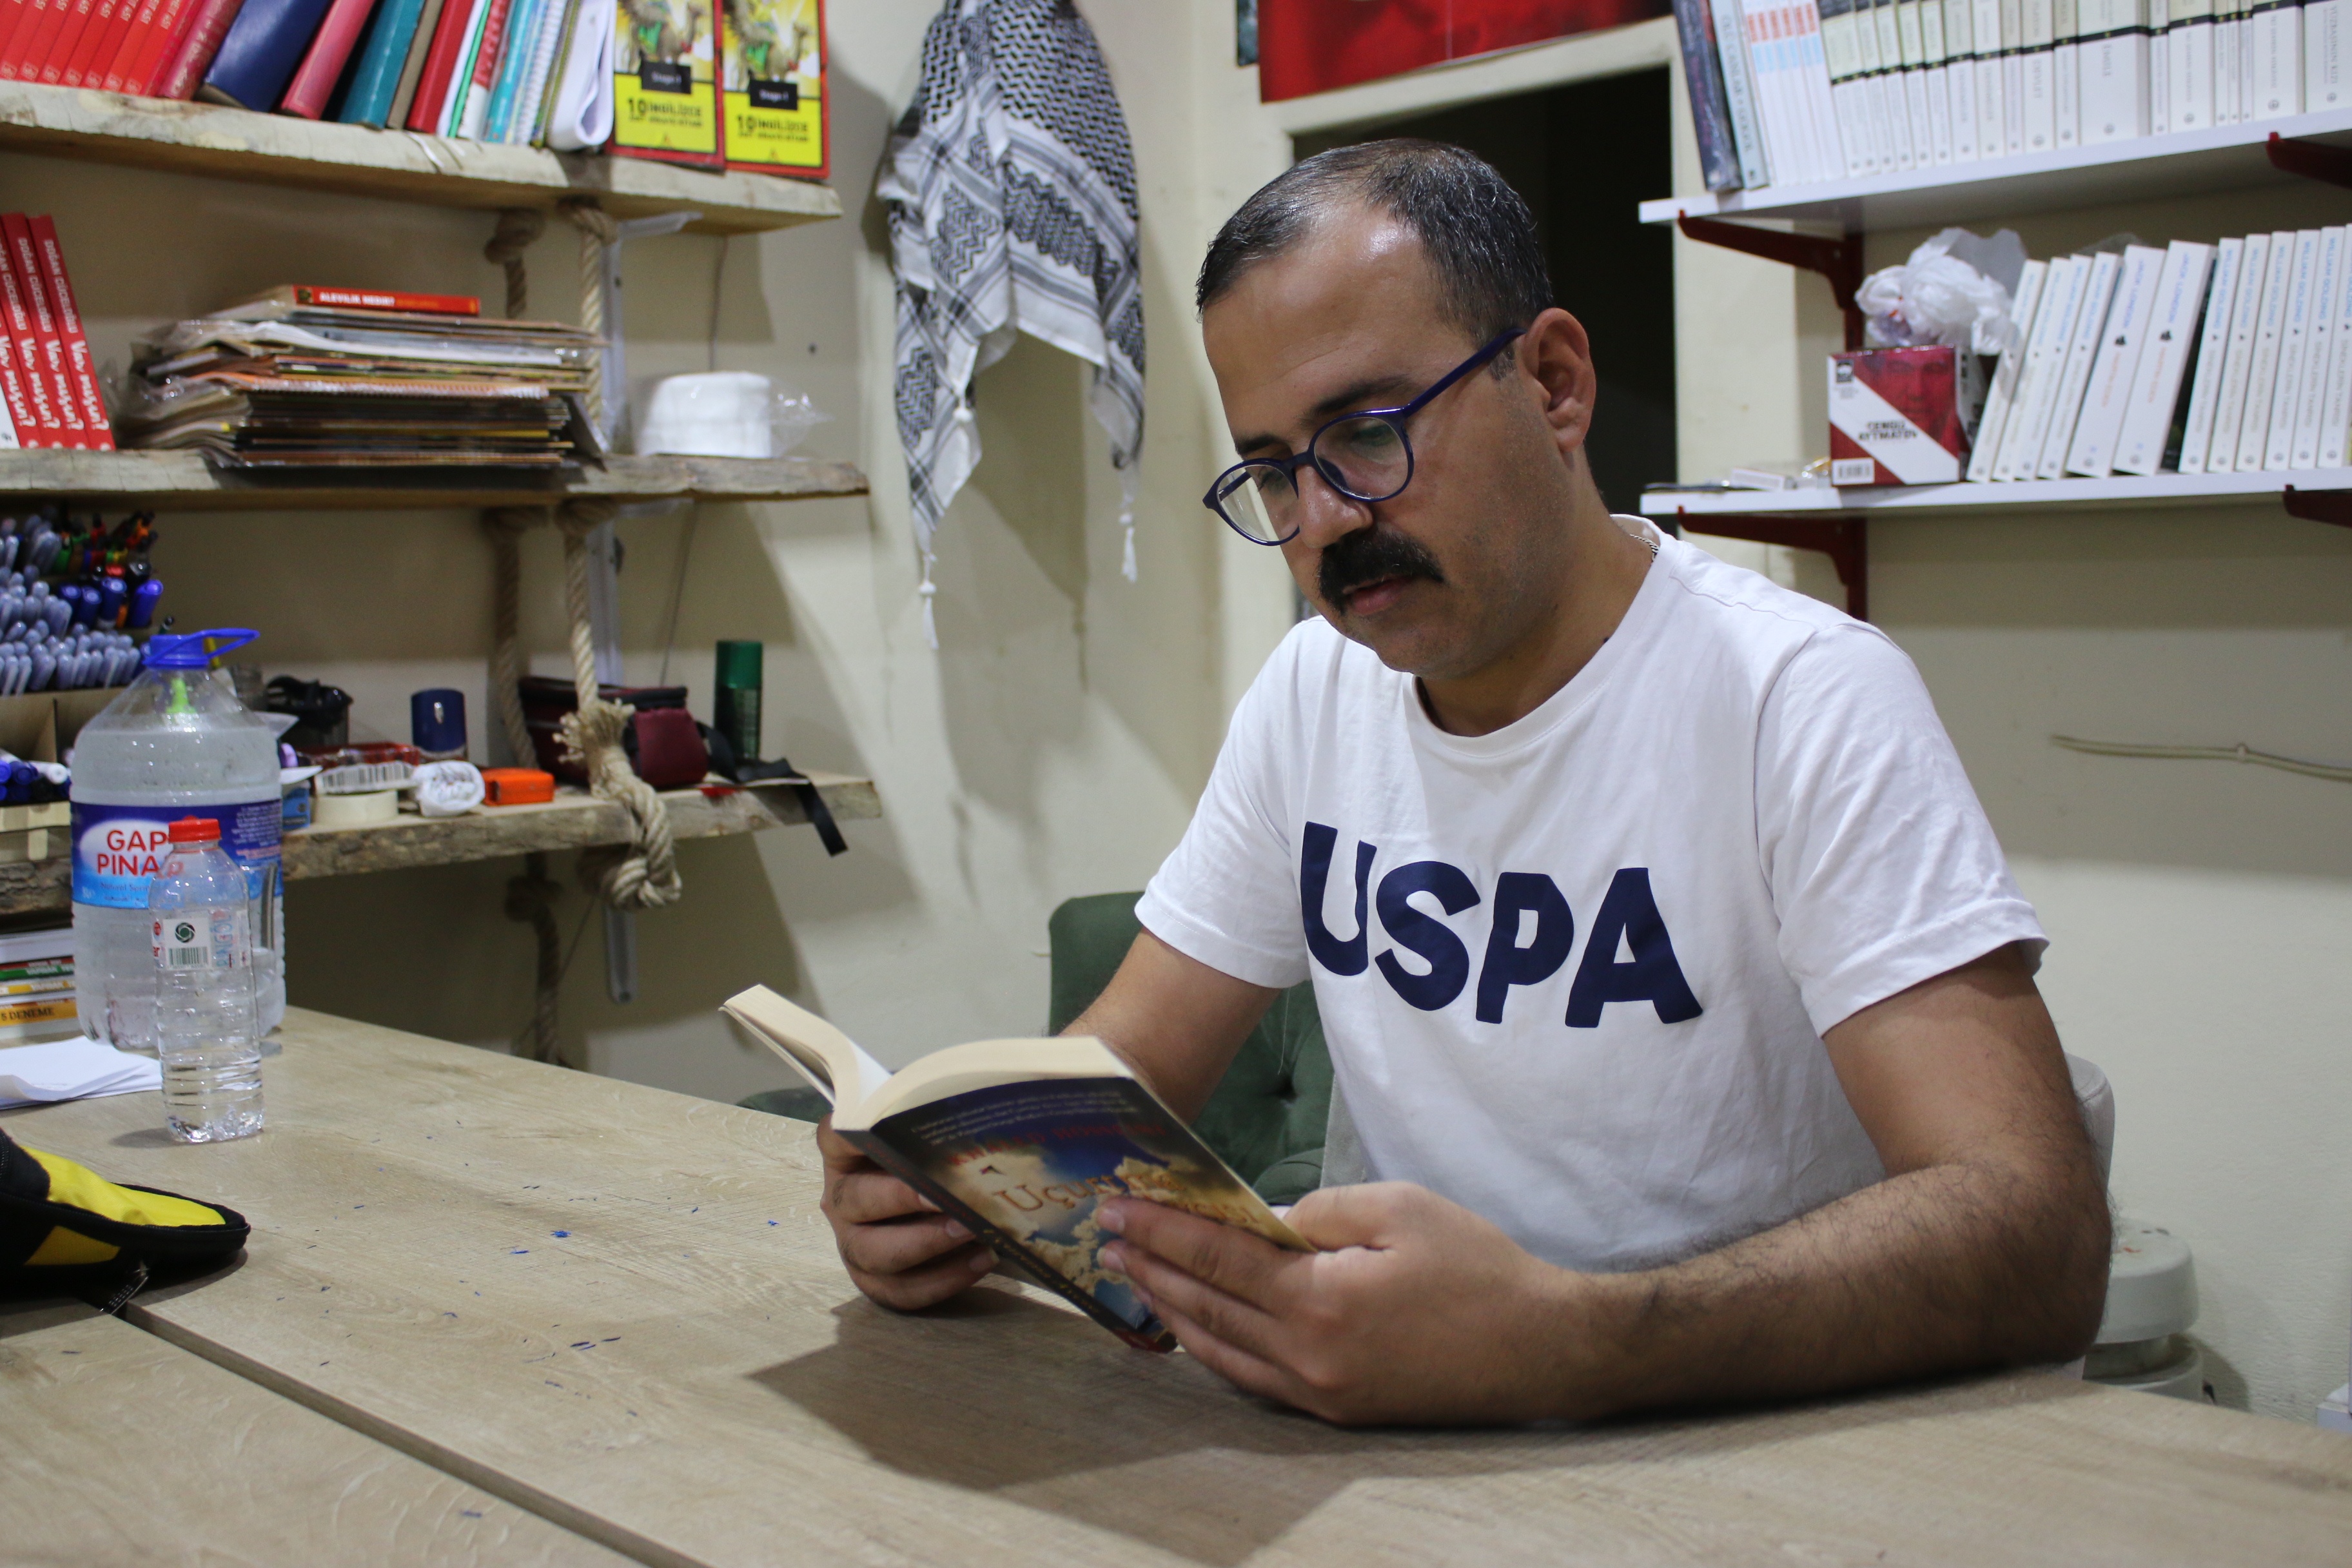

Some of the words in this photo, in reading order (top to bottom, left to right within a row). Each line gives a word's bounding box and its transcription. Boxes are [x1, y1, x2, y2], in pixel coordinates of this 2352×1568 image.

[2300, 240, 2312, 279] WILLIAM
[2325, 237, 2337, 276] WILLIAM
[2293, 280, 2306, 322] GOLDING
[2319, 277, 2331, 320] GOLDING
[46, 339, 63, 372] Var
[71, 340, 88, 373] Var
[106, 829, 168, 852] GAP
[1300, 821, 1703, 1028] USPA
[9, 1007, 54, 1020] DENEME
